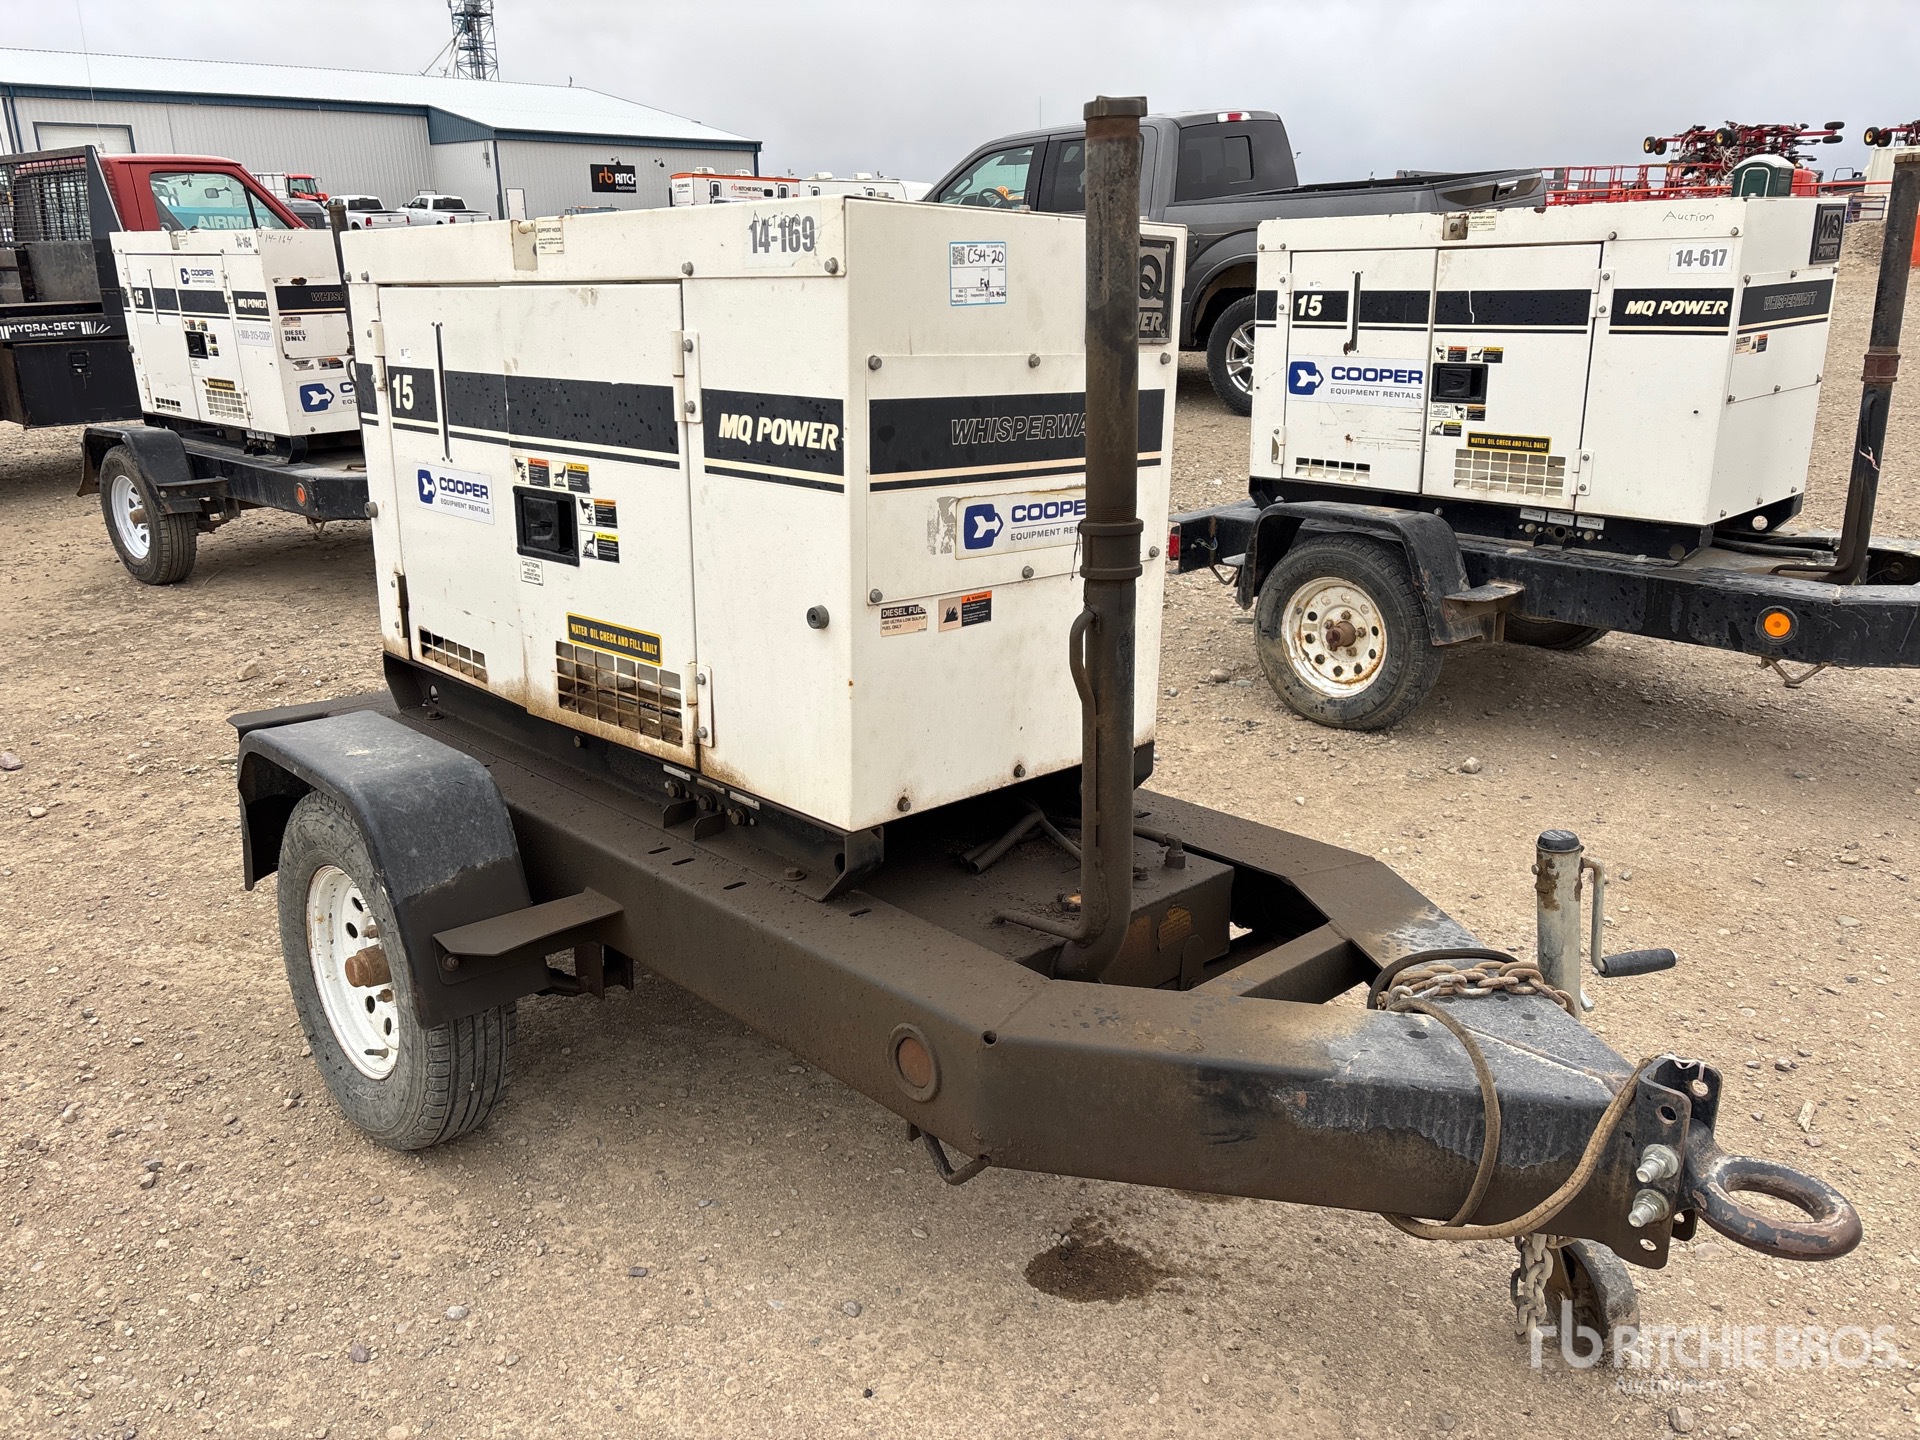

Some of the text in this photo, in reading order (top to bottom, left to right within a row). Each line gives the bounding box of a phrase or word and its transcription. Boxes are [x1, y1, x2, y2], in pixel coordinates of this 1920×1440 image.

[1662, 211, 1715, 222] Auction
[748, 216, 815, 253] 14-169
[1675, 248, 1728, 267] 14-617
[1817, 245, 1839, 259] POWER
[191, 269, 214, 277] COOPER
[1138, 254, 1163, 300] Q
[134, 290, 145, 306] 15
[248, 299, 268, 309] POWER
[1298, 294, 1323, 317] 15
[1624, 300, 1728, 317] MQ POWER
[1331, 366, 1423, 384] COOPER
[392, 373, 414, 410] 15
[1330, 387, 1422, 399] EQUIPMENT RENTALS
[719, 413, 839, 451] MQ POWER
[952, 413, 1087, 446] WHISPERWA
[1470, 437, 1486, 445] WATER
[1496, 438, 1512, 446] CHECK
[1512, 439, 1522, 447] AND
[1522, 440, 1532, 448] FILL
[1533, 441, 1547, 449] DAILY
[439, 476, 489, 500] COOPER
[440, 498, 491, 515] EQUIPMENT RENTALS
[1011, 499, 1087, 523] COOPE
[1010, 527, 1061, 542] EQUIPMENT
[882, 606, 907, 618] DIESEL
[570, 623, 658, 655] WATER OIL CHECK AND FILL DAILY
